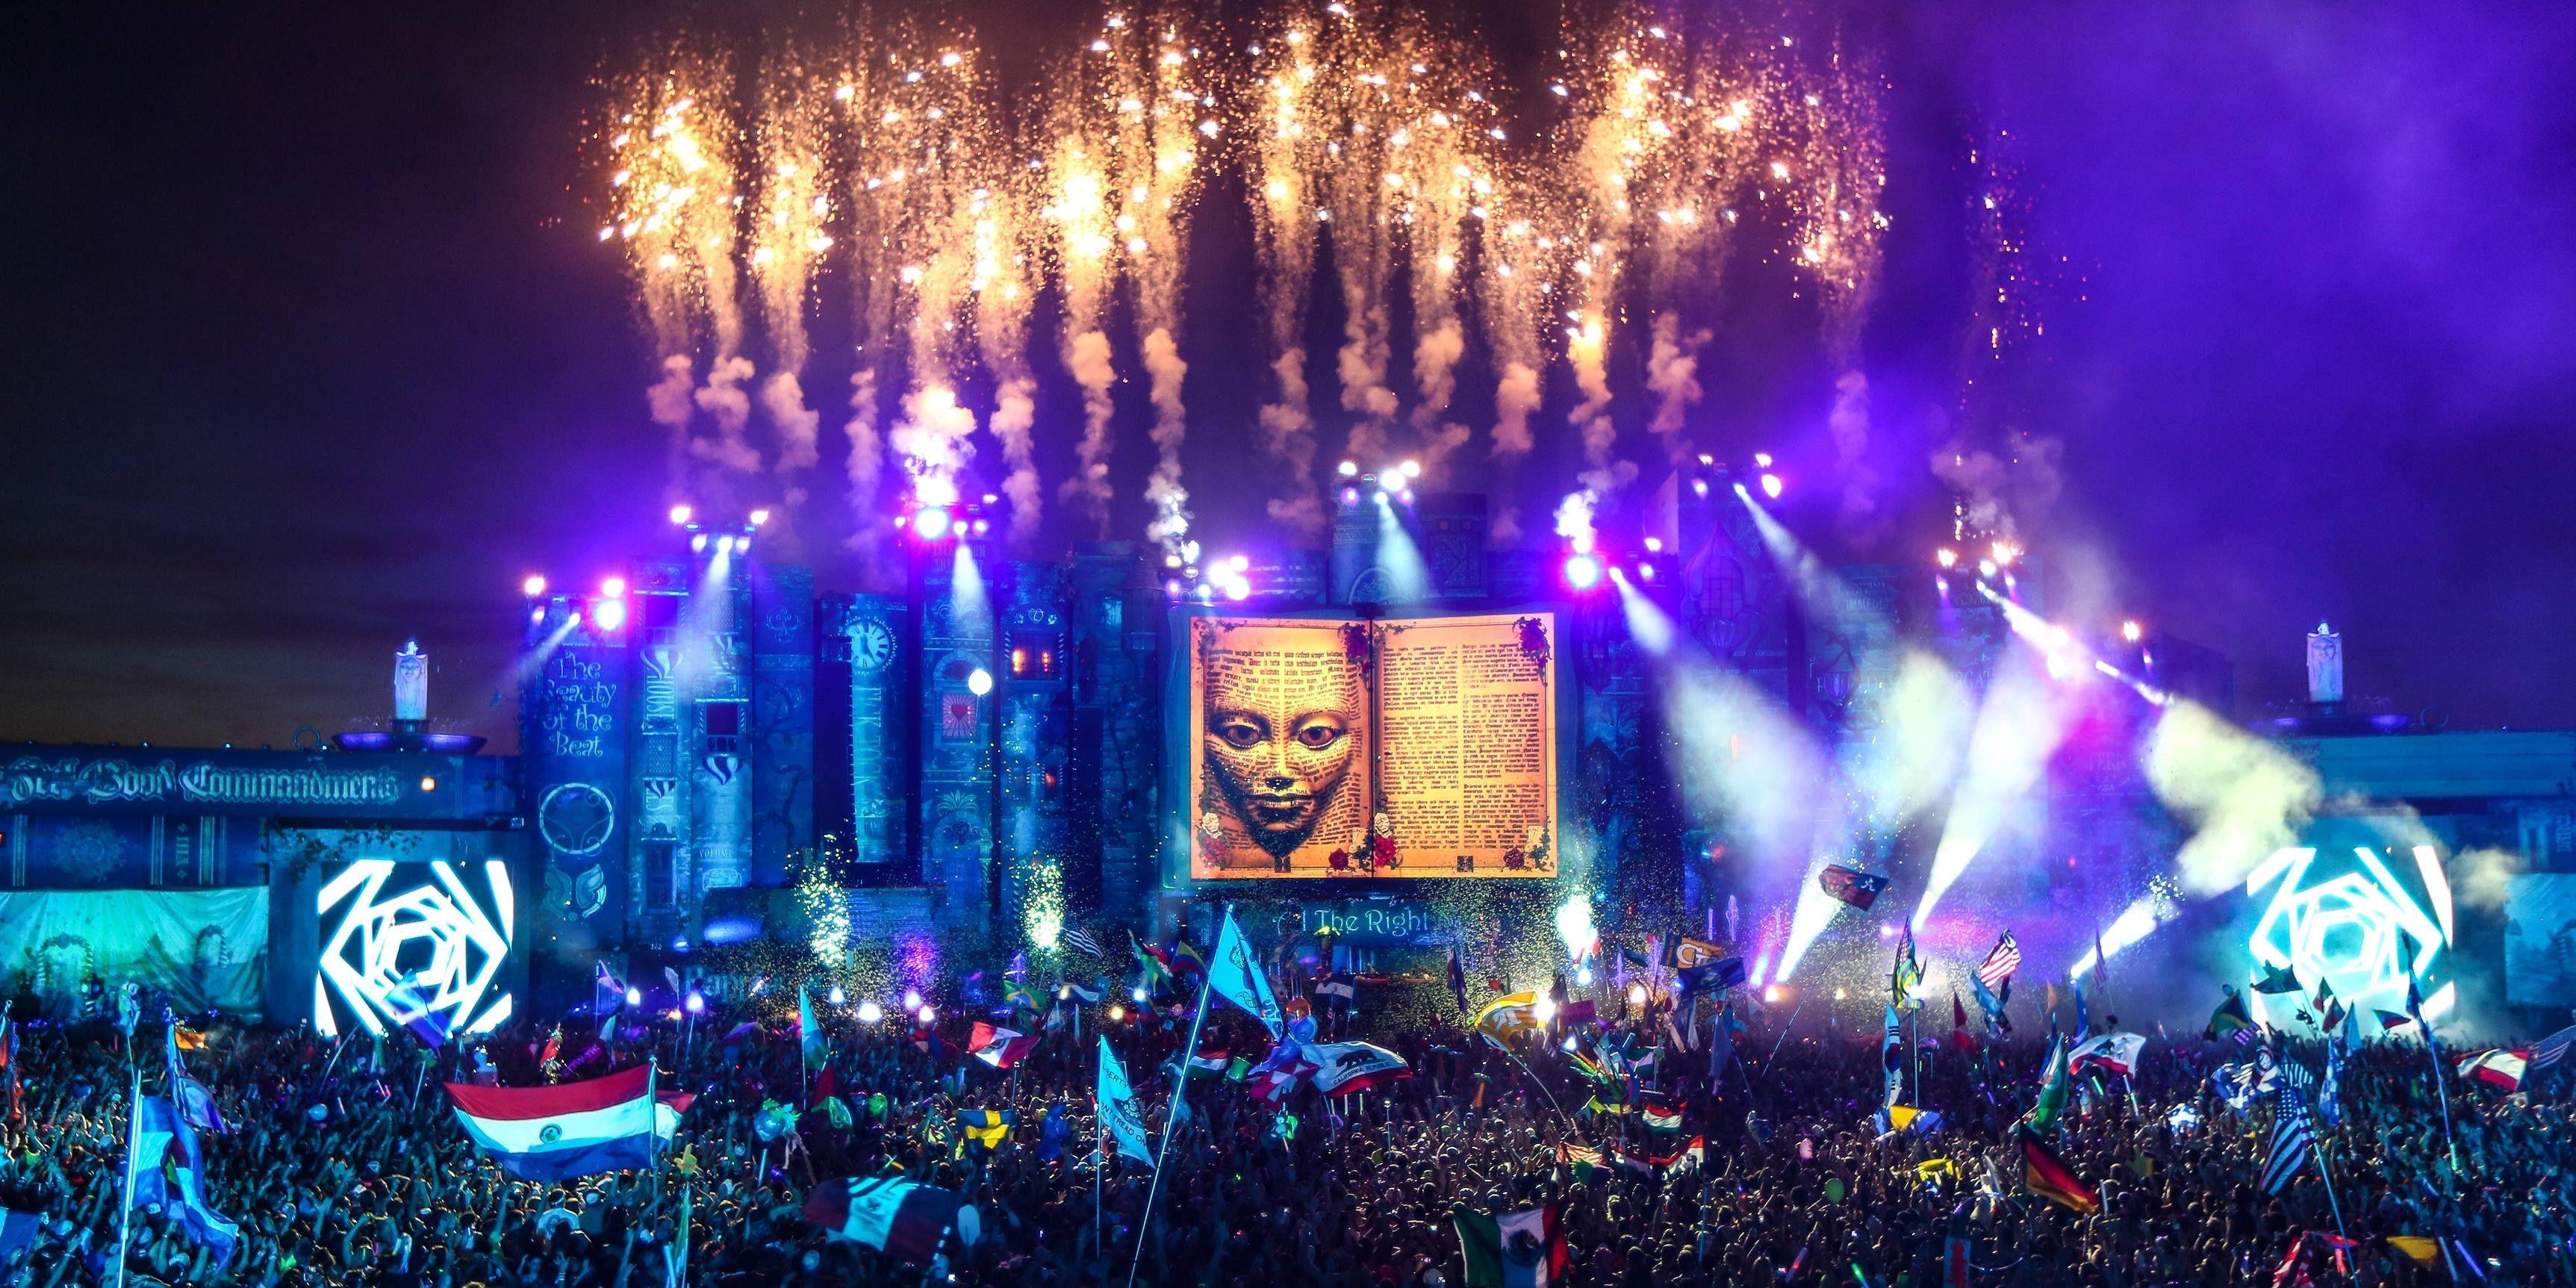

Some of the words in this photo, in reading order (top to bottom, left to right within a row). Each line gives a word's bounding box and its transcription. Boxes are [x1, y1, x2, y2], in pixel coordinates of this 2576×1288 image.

[552, 650, 601, 680] The
[574, 703, 612, 731] the
[550, 731, 603, 757] Beat
[179, 759, 400, 804] Commandments
[1314, 909, 1359, 934] The
[1365, 906, 1428, 936] Right
[1113, 1115, 1134, 1136] TREAD
